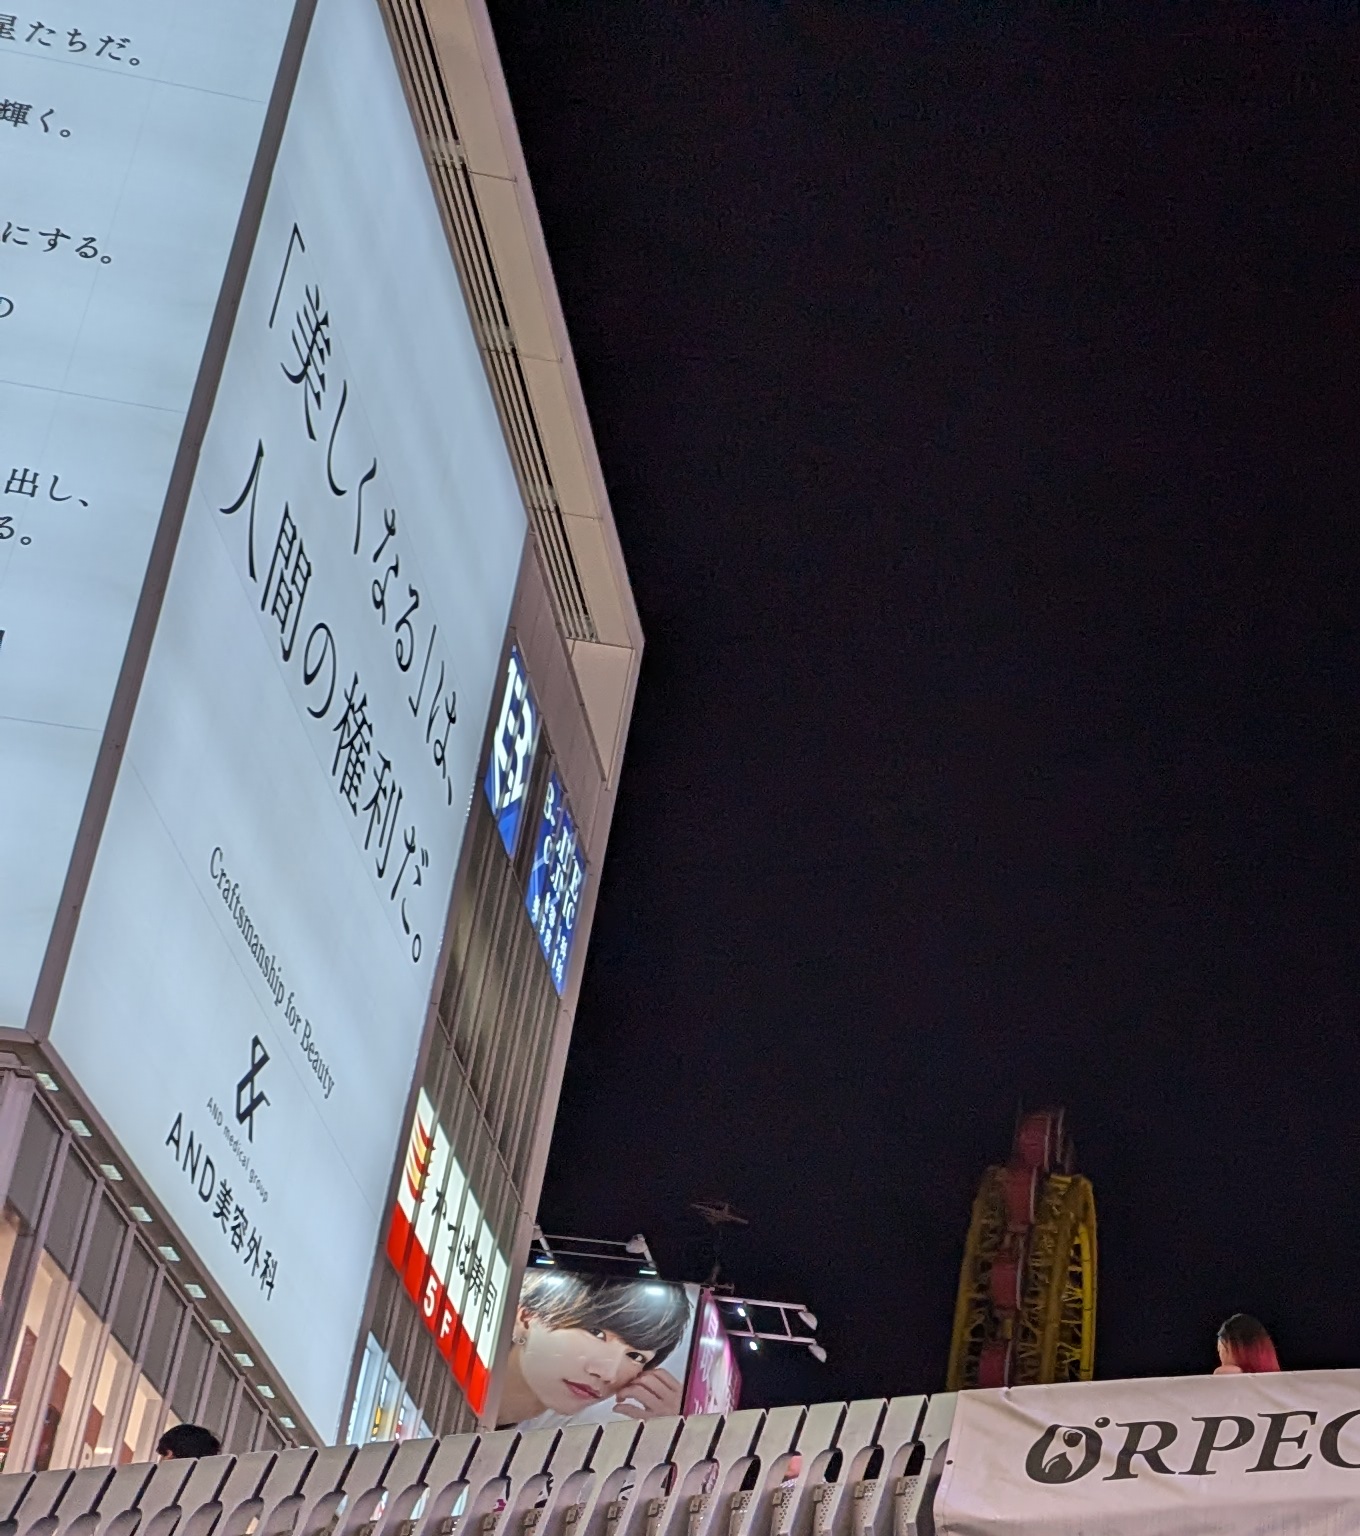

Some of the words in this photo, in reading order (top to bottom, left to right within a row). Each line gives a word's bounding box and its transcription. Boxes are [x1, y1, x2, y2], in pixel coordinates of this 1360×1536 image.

[2, 221, 112, 264] にする。
[4, 467, 89, 507] 出し、
[218, 438, 424, 963] 人間の権利だ。
[209, 846, 285, 1006] Craftsmanship
[285, 992, 302, 1034] for
[302, 1018, 335, 1099] Beauty
[206, 1096, 224, 1128] AND
[223, 1122, 249, 1173] medical
[248, 1167, 269, 1204] group
[166, 1111, 279, 1301] AND美容外科
[423, 1272, 453, 1340] 5F
